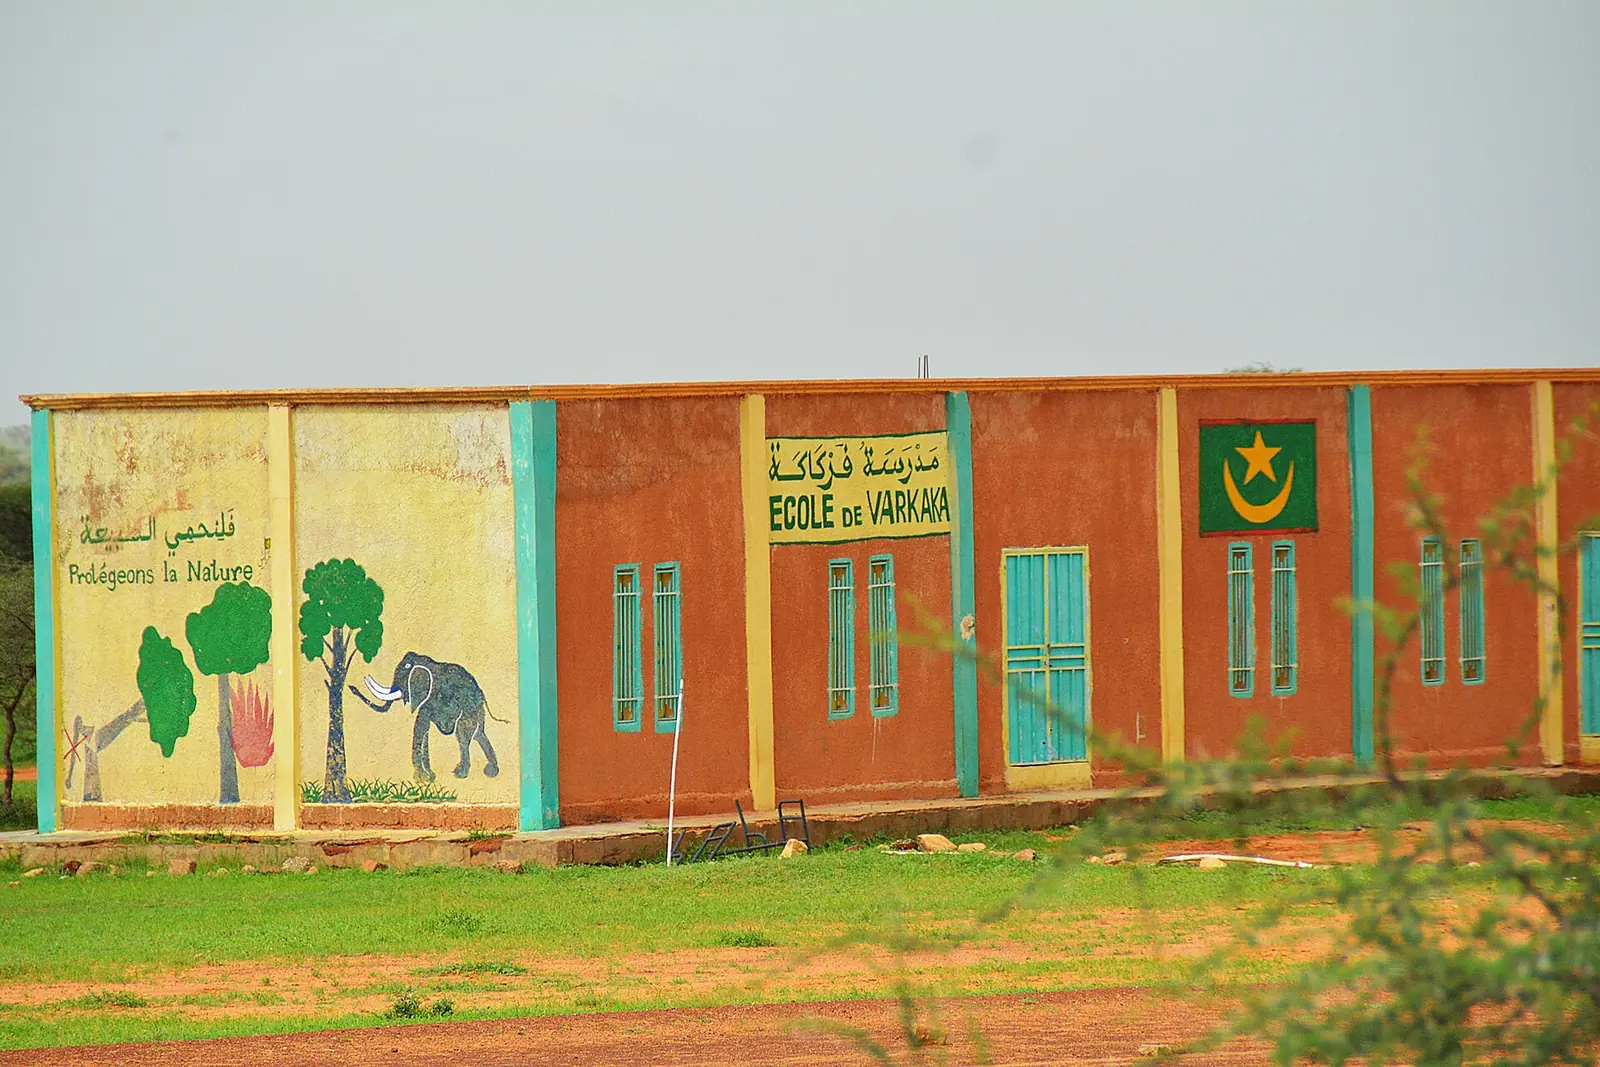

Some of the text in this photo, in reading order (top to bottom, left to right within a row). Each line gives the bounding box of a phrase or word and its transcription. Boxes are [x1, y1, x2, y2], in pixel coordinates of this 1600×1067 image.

[769, 487, 951, 531] ECOLE DE VARKAKA
[69, 561, 154, 591] Protégeons
[163, 560, 178, 582] la
[188, 559, 253, 582] Nature
